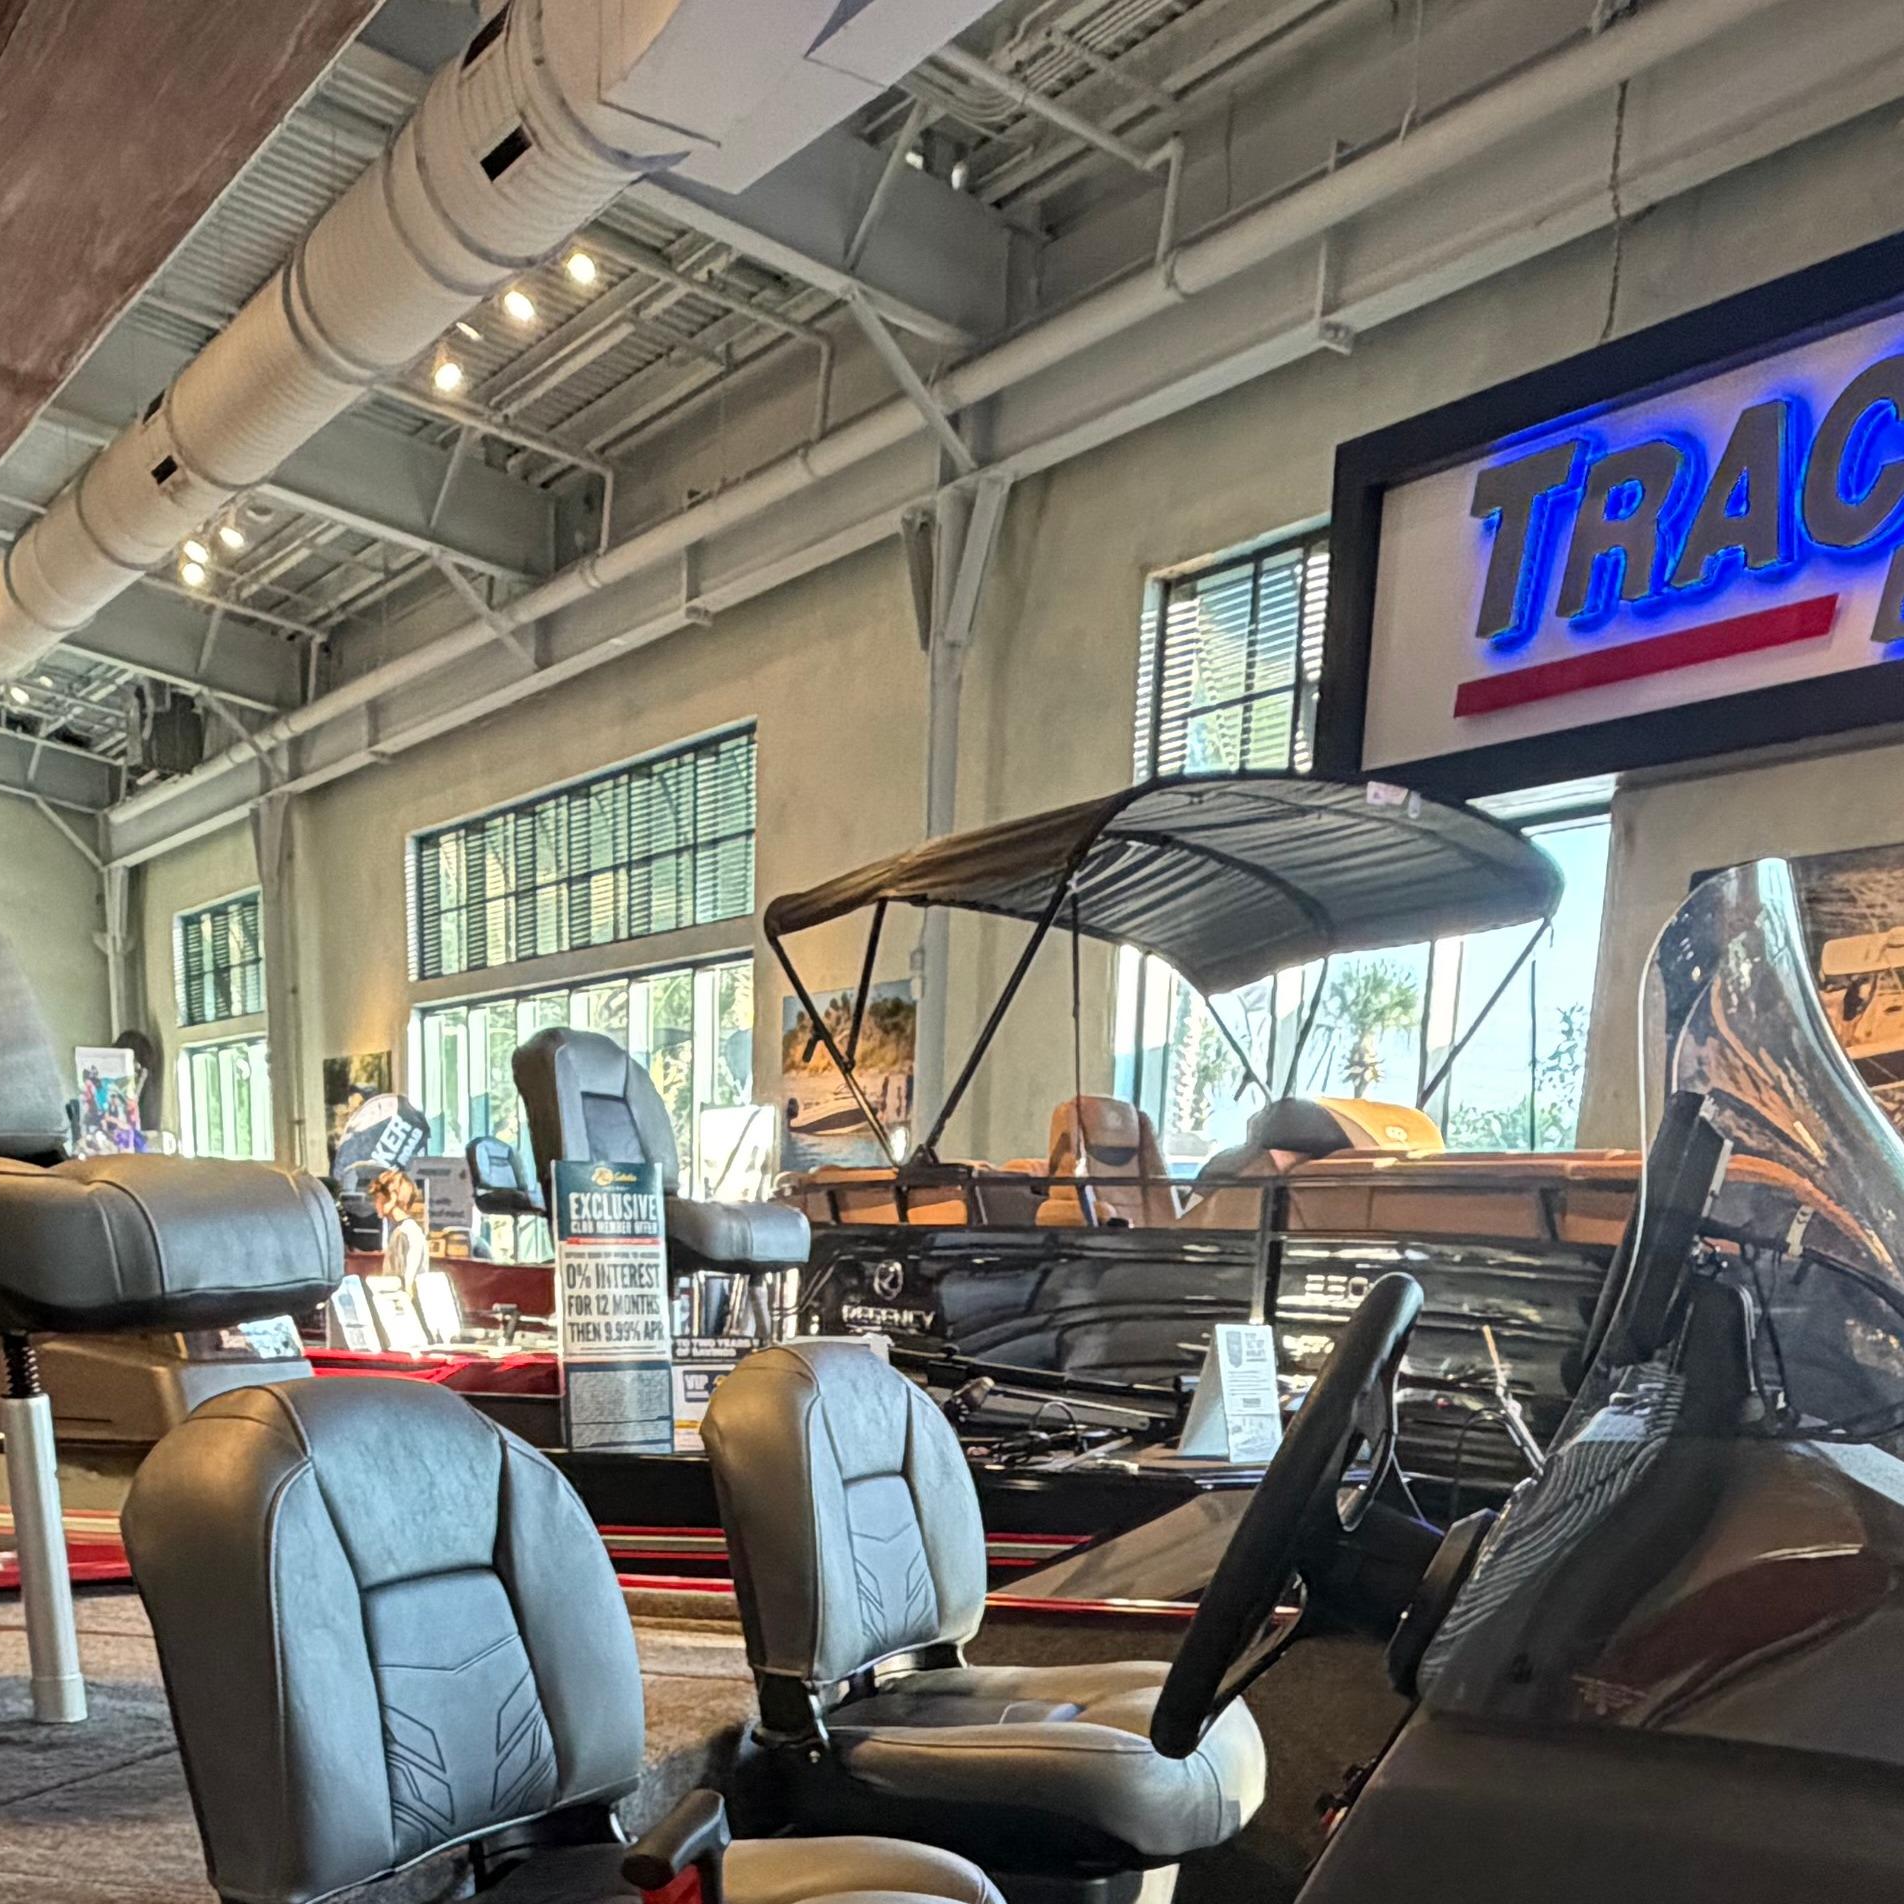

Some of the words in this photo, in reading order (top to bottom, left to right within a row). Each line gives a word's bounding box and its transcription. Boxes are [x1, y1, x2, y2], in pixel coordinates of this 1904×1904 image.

[569, 1192, 657, 1220] EXCLUSIVE
[566, 1263, 592, 1289] 0%
[596, 1263, 660, 1289] INTEREST
[567, 1295, 593, 1316] FOR
[595, 1294, 609, 1316] 12
[612, 1294, 660, 1316] MONTHS
[567, 1322, 602, 1343] THEN
[643, 1320, 665, 1341] APR
